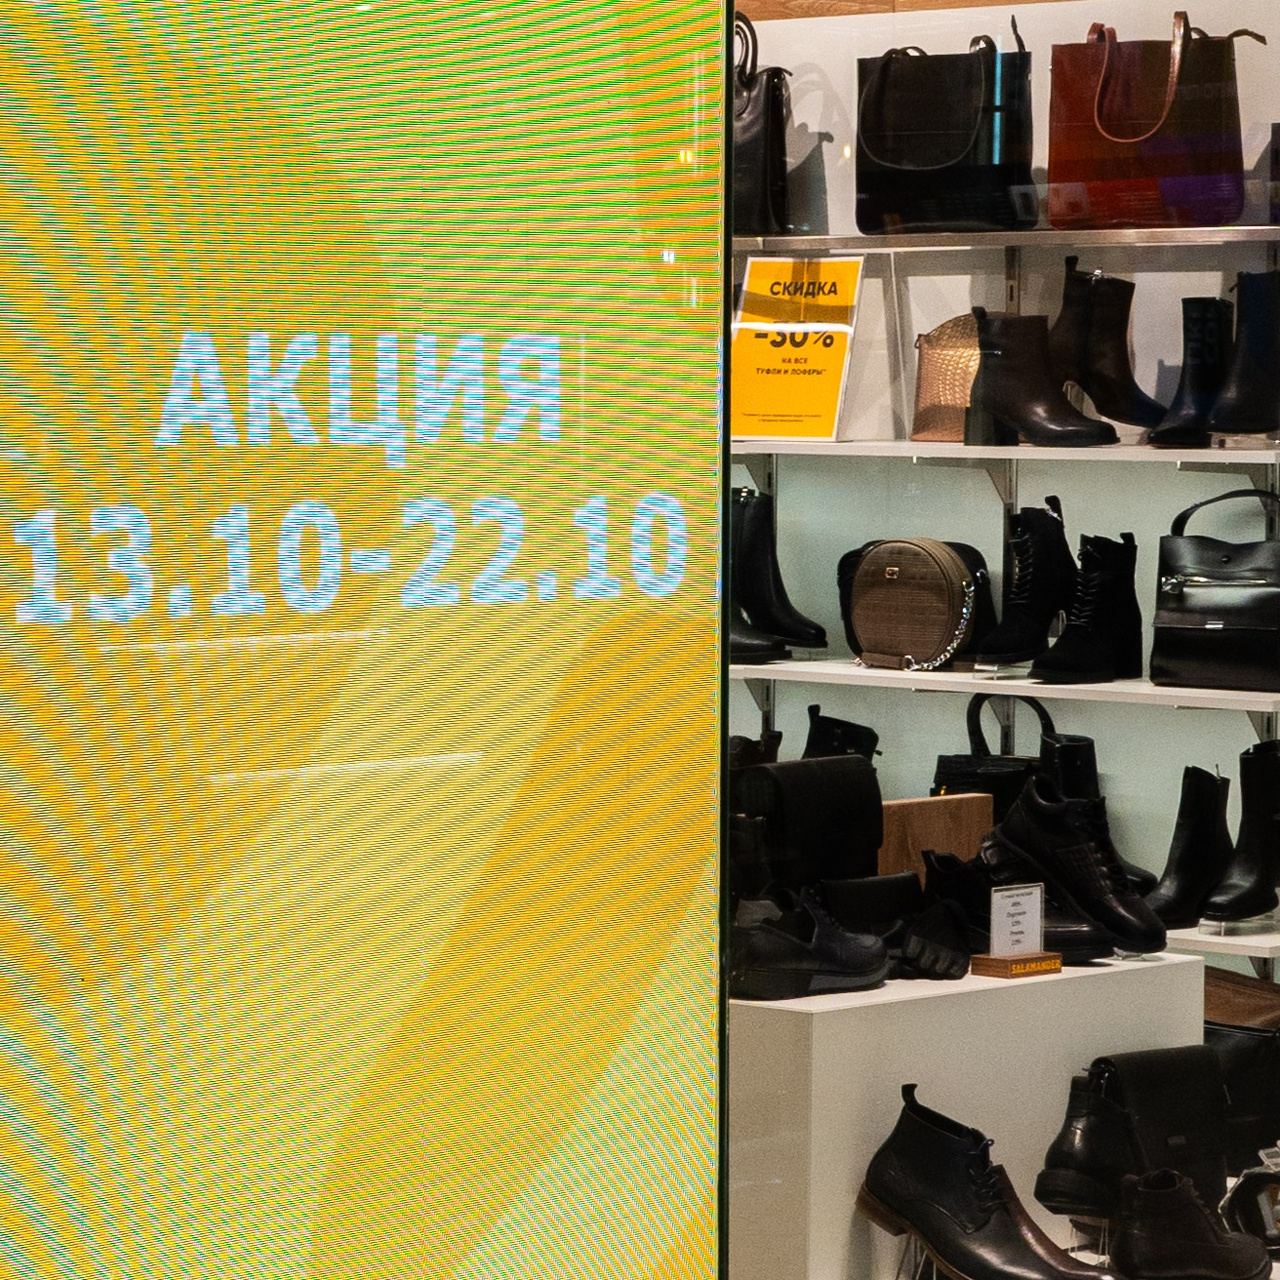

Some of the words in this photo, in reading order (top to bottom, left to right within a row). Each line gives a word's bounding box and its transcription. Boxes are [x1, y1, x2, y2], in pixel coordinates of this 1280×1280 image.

[769, 281, 838, 299] СКИДКА
[754, 319, 834, 349] -30%
[155, 330, 561, 470] АКЦИЯ
[12, 490, 689, 624] 13.10-22.10
[1011, 959, 1061, 973] SALAMANDER
